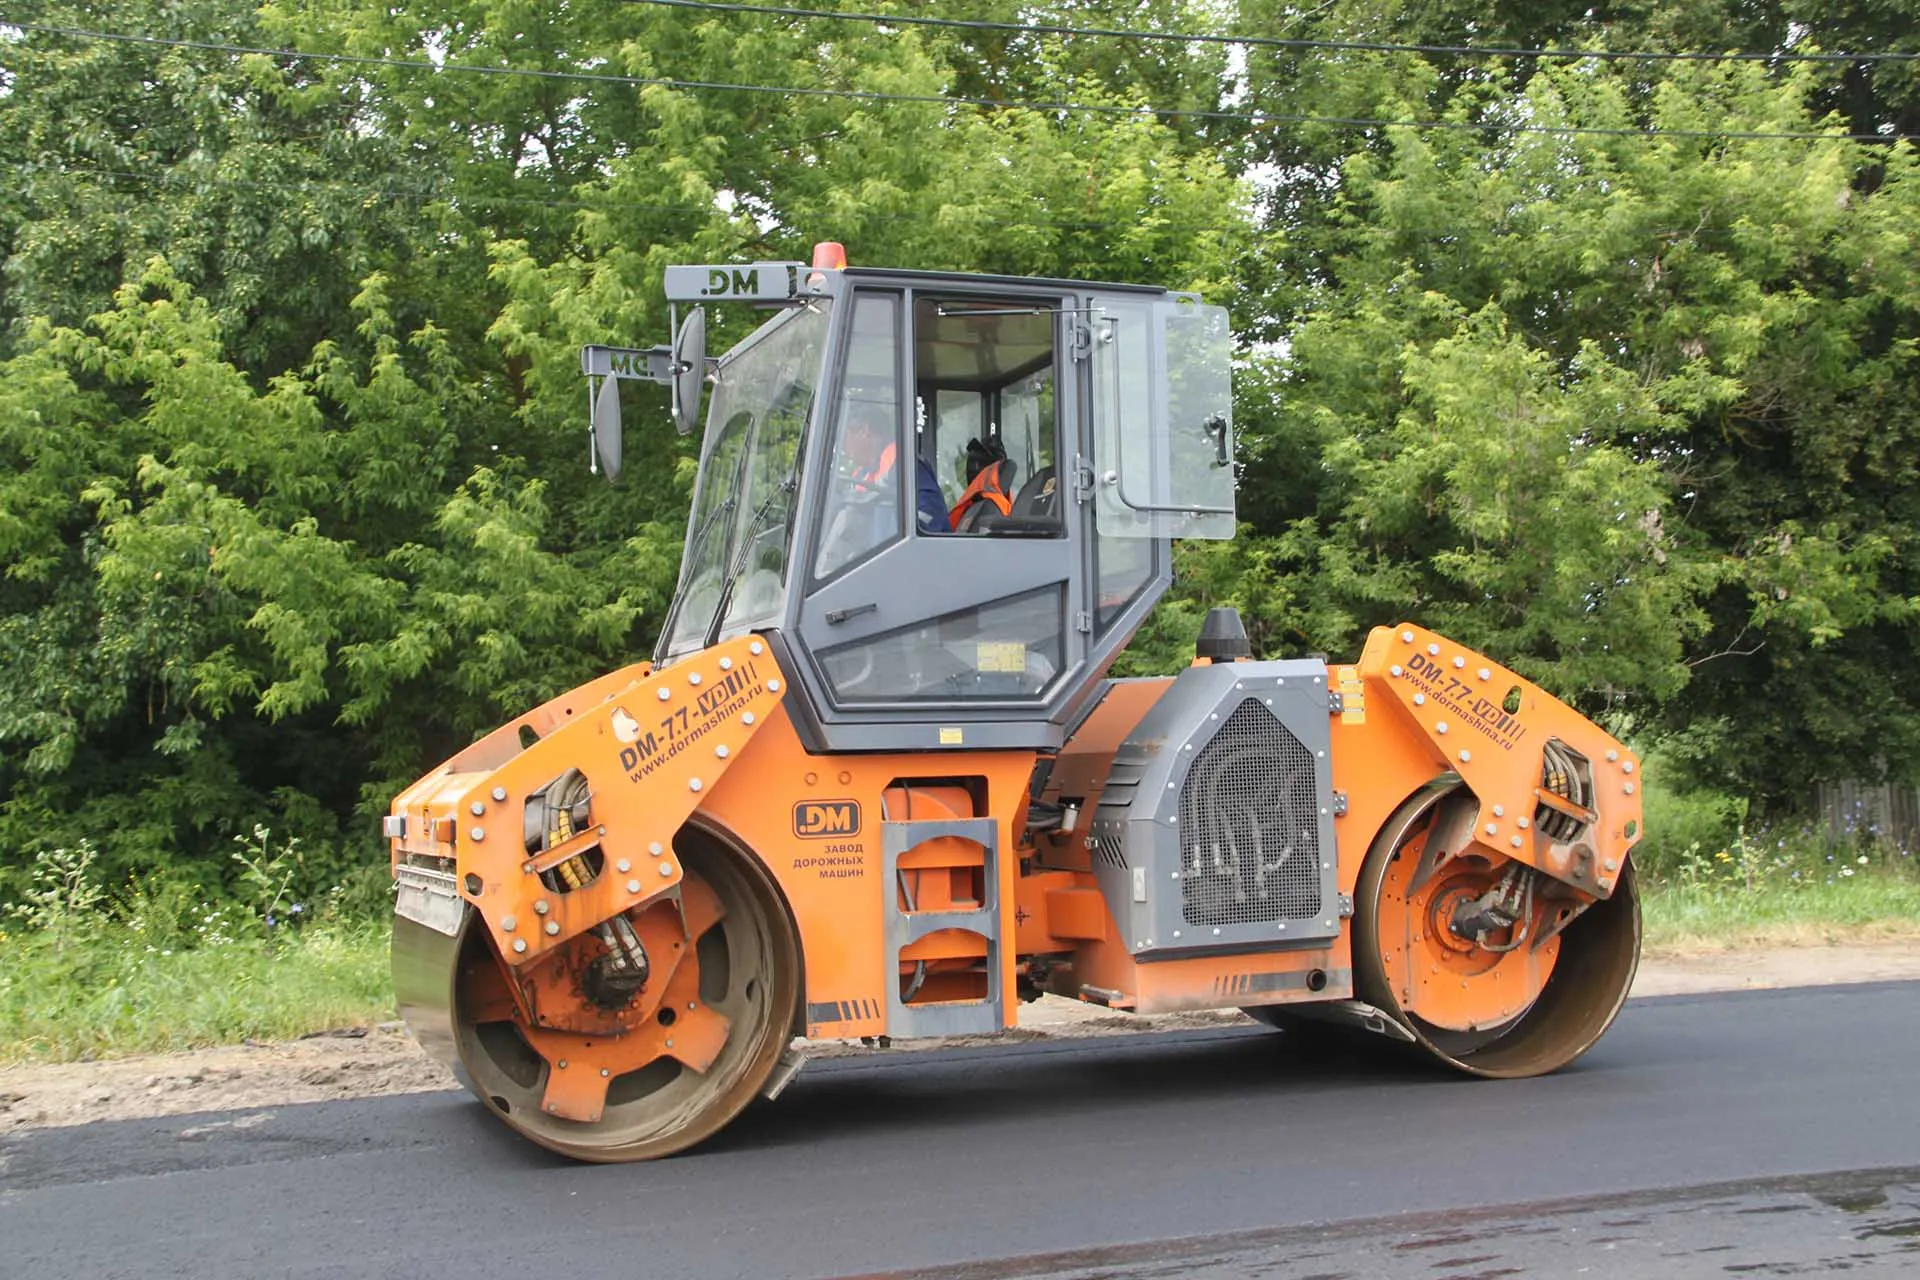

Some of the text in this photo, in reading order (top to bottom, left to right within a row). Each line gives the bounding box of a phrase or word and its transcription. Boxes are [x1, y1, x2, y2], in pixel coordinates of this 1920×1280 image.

[1401, 669, 1513, 751] www.dormashina.ru
[630, 684, 763, 784] www.dormashina.ru
[824, 843, 864, 853] ЗАВОД
[793, 856, 864, 868] ДОРОЖНЫХ
[819, 868, 864, 878] МАШИН
